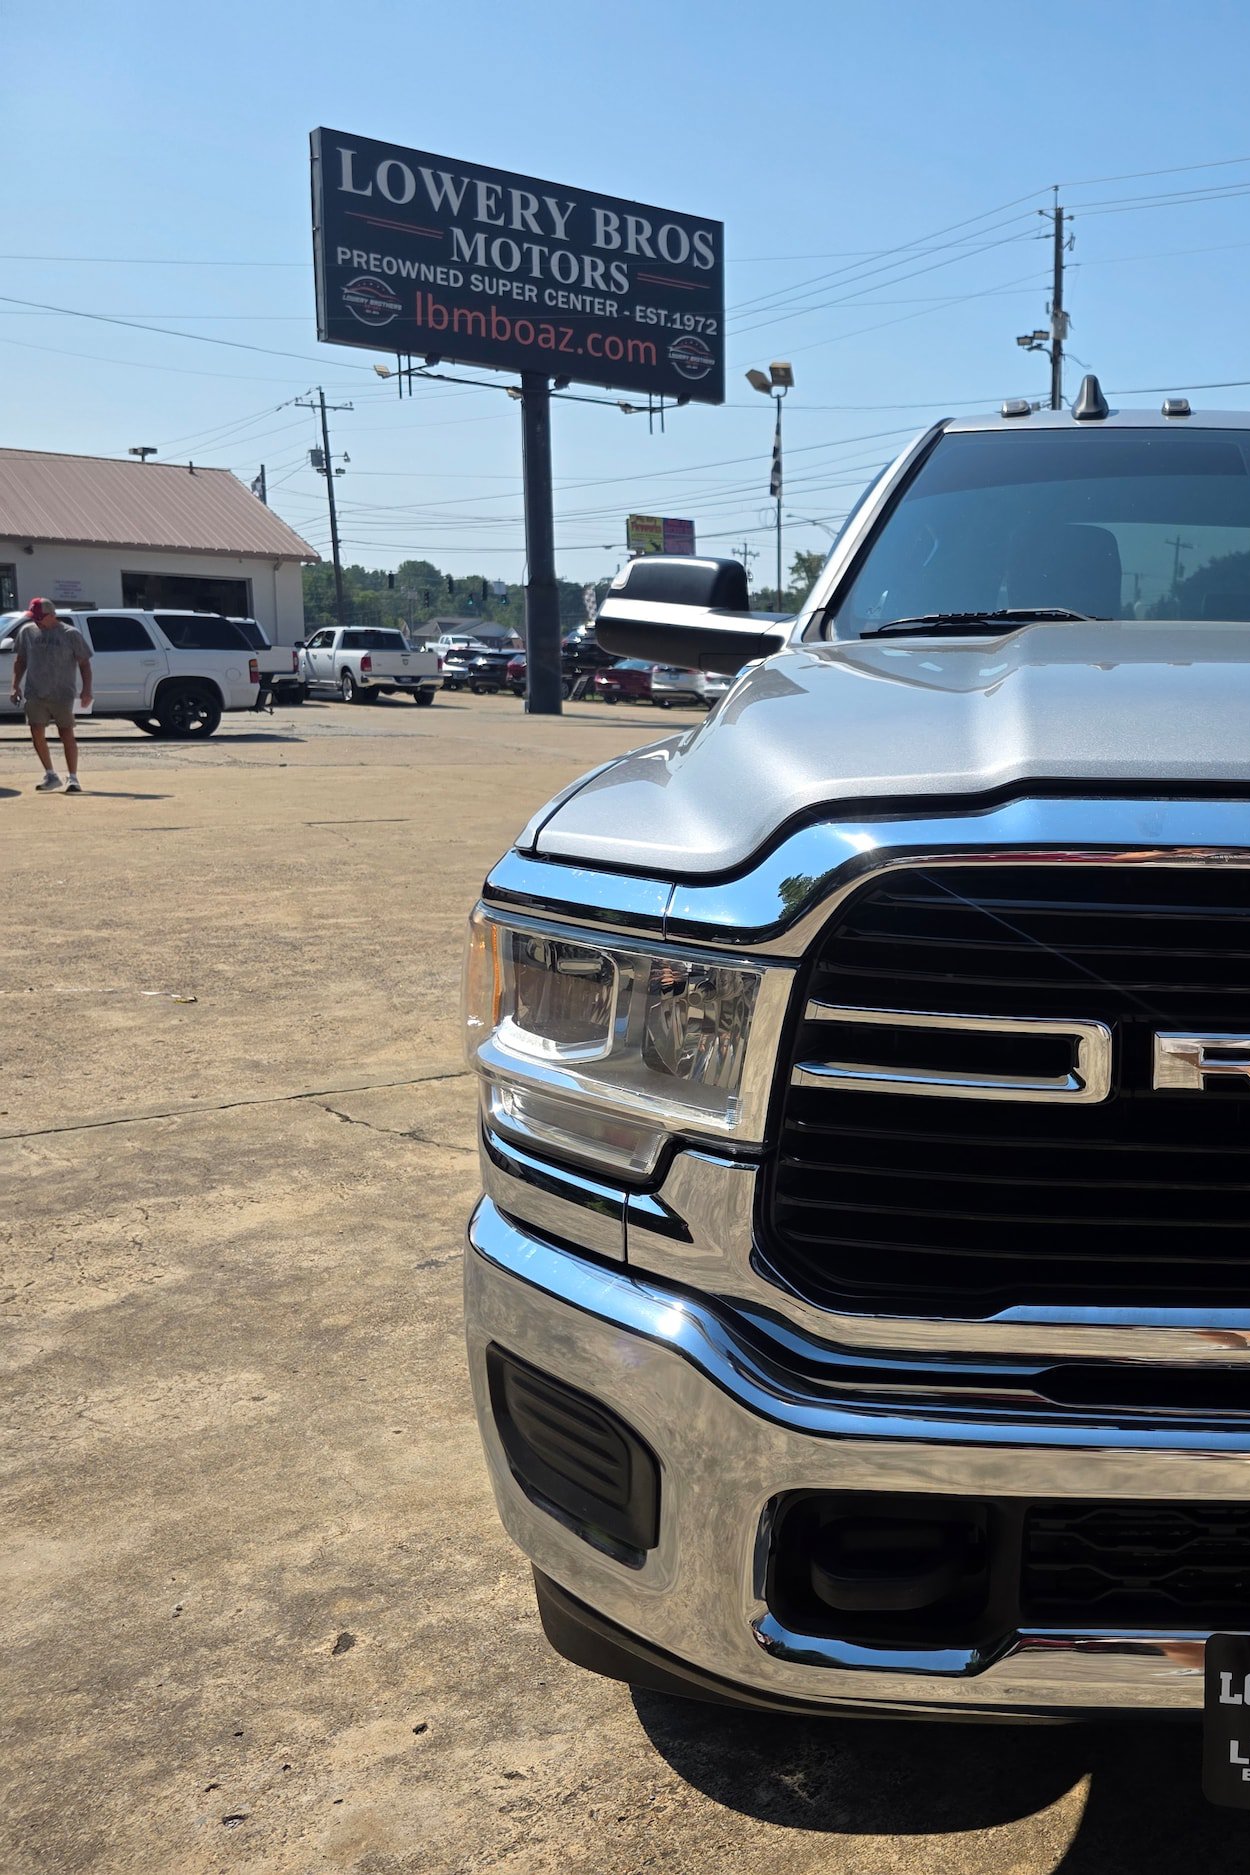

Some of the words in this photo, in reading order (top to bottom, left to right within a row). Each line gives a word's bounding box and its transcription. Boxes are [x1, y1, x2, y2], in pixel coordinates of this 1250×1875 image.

[336, 147, 577, 241] LOWERY
[591, 207, 715, 270] BROS
[336, 246, 464, 288] PREOWNED
[470, 273, 538, 303] SUPER
[544, 289, 618, 317] CENTER
[635, 306, 718, 336] EST.1972
[449, 226, 630, 295] MOTORS
[415, 291, 657, 366] lbmboaz.com
